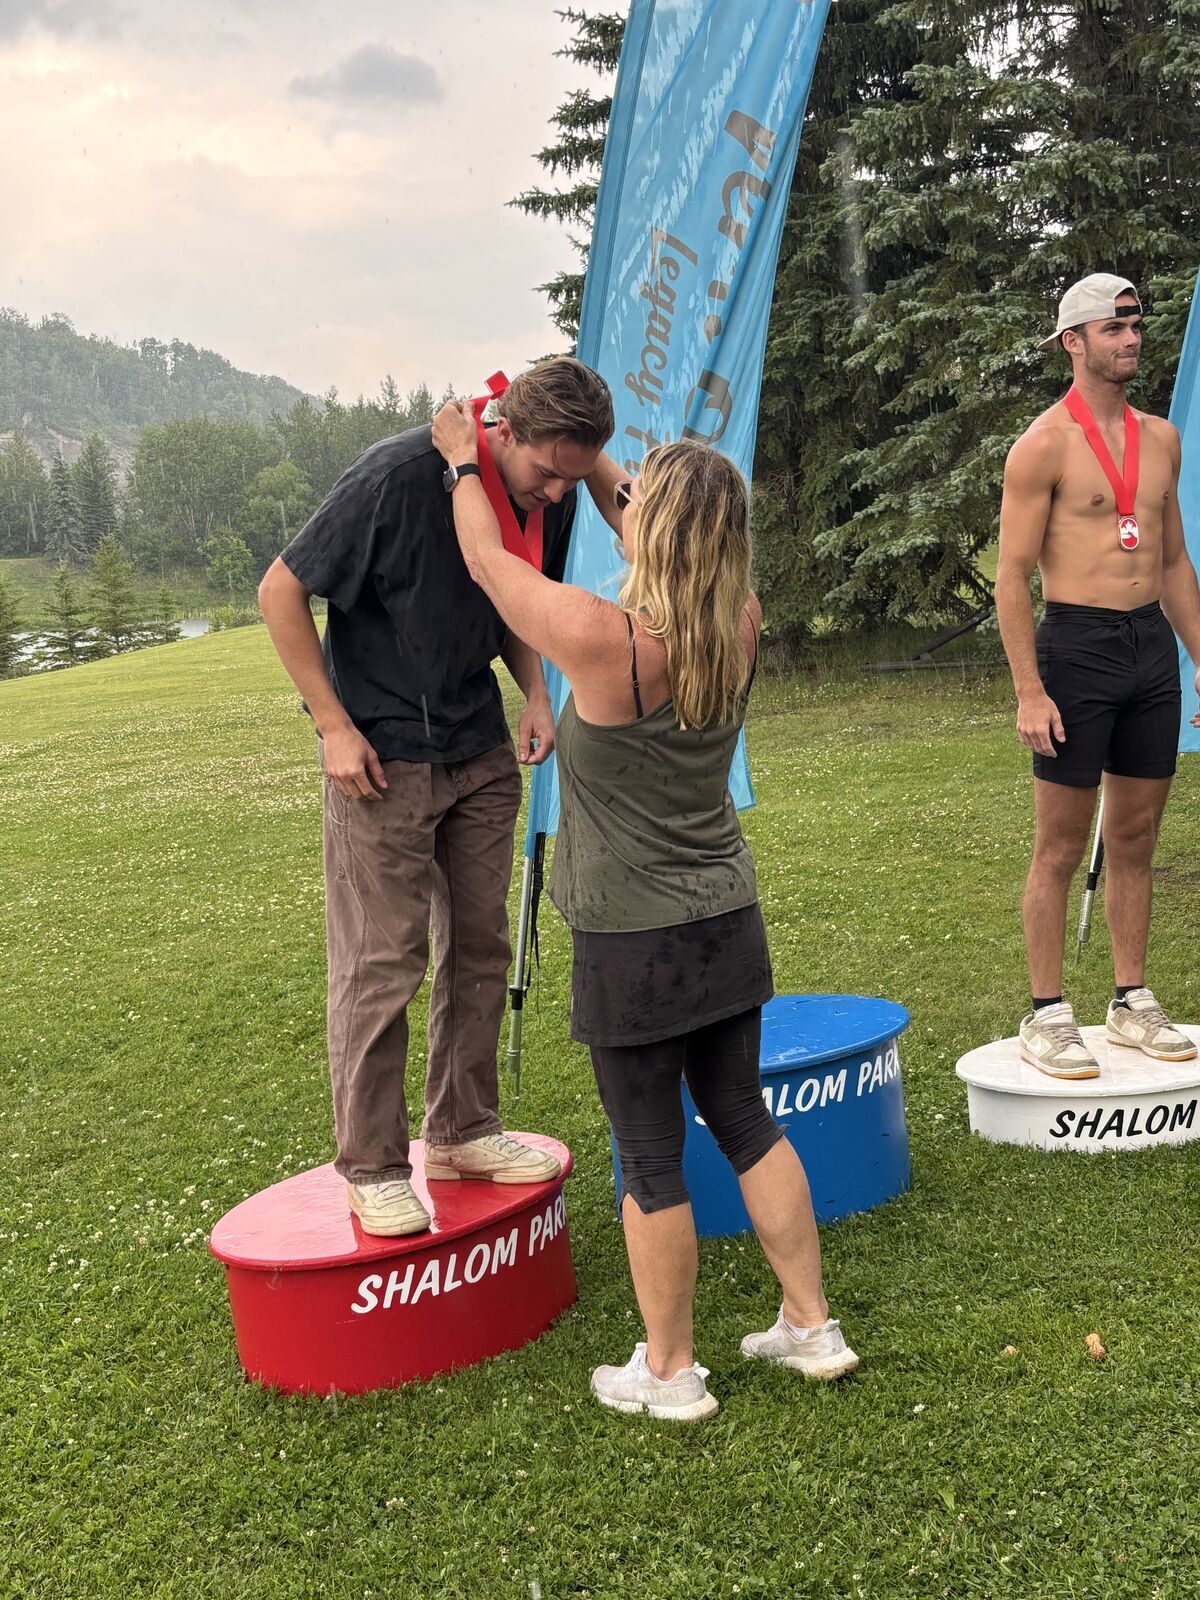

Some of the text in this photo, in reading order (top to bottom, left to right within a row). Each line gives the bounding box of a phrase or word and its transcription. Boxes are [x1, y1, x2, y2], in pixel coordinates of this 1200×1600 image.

[625, 225, 698, 407] Legacy
[1049, 1099, 1198, 1140] SHALOM
[351, 1228, 518, 1314] SHALOM
